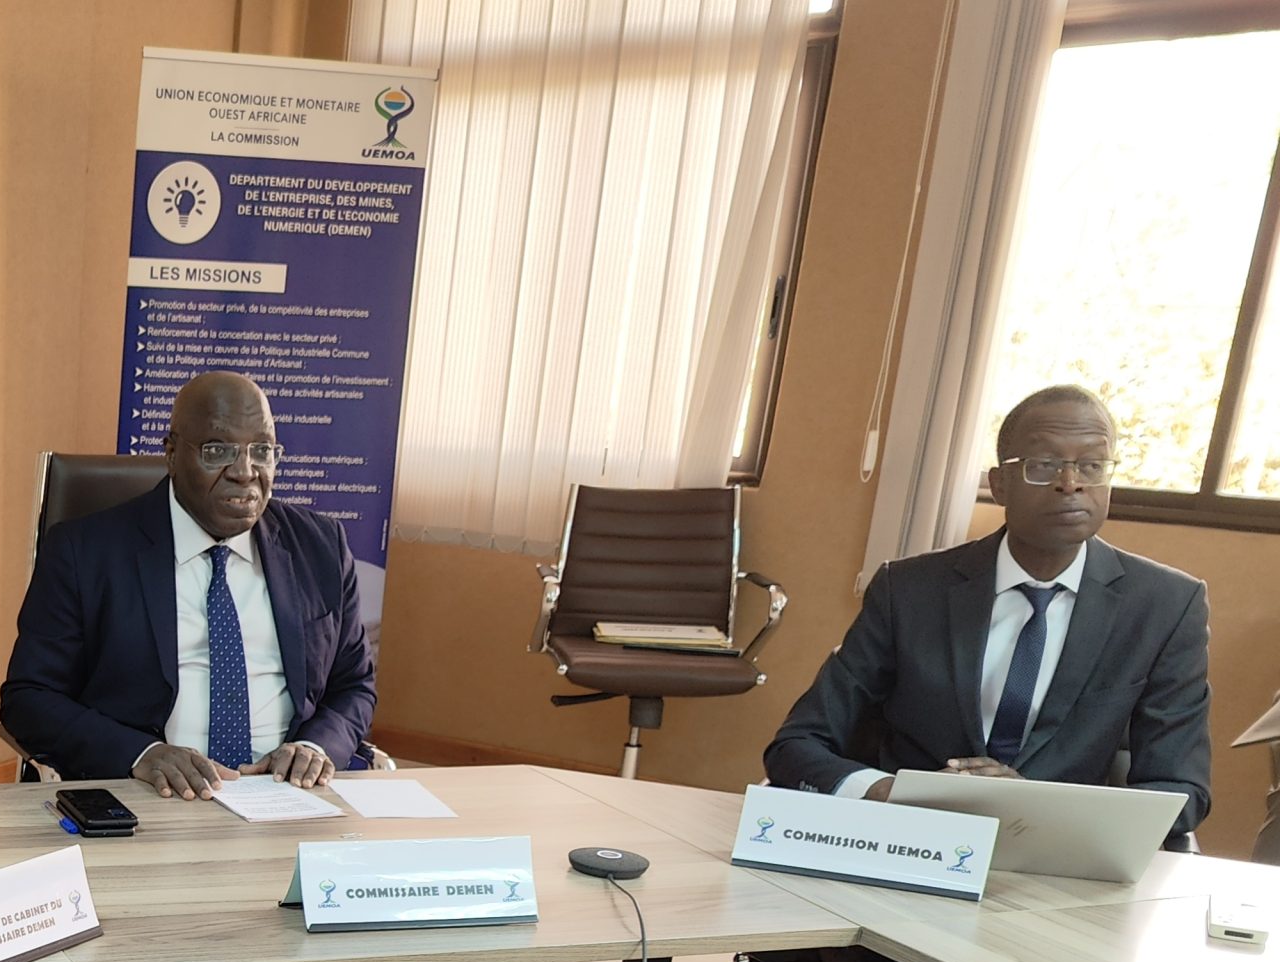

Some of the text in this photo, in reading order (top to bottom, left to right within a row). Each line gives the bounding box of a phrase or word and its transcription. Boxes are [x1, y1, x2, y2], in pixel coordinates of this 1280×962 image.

[155, 88, 361, 113] UNION ECONOMIQUE ET MONETAIRE
[209, 108, 307, 125] OUEST AFRICAINE
[210, 131, 300, 147] LA COMMISSION
[361, 148, 416, 161] UEMOA
[229, 174, 413, 195] DEPARTEMENT DU DEVELOPPEMENT
[245, 190, 395, 210] DE L'ENTREPRISE, DES MINES,
[237, 205, 400, 224] DE L'ENERGIE ET DE L'ECONOMIE
[264, 220, 372, 238] NUMERIQUE (DEMEN)
[149, 266, 262, 285] LES MISSIONS
[147, 312, 155, 322] et
[156, 313, 166, 322] de
[148, 299, 186, 309] Promotion
[187, 301, 196, 310] du
[198, 303, 225, 312] secteur
[249, 304, 259, 313] de
[260, 304, 267, 313] la
[314, 307, 328, 317] des
[329, 308, 369, 319] entreprises
[147, 327, 198, 338] Renforcement
[199, 329, 209, 338] de
[209, 329, 217, 338] la
[218, 330, 263, 341] concertation
[264, 332, 282, 342] avec
[283, 332, 290, 342] le
[291, 333, 319, 343] secteur
[146, 341, 164, 352] Suivi
[166, 342, 176, 352] de
[177, 343, 184, 352] la
[185, 343, 201, 353] mise
[203, 344, 213, 353] en
[240, 345, 250, 355] de
[251, 346, 258, 355] la
[260, 346, 290, 357] Politique
[291, 347, 331, 358] Industrielle
[331, 348, 369, 359] Commune
[146, 355, 154, 364] et
[155, 355, 165, 364] de
[166, 355, 174, 365] la
[175, 354, 205, 366] Politique
[144, 368, 189, 379] Amélioration
[267, 373, 275, 382] et
[276, 373, 283, 383] la
[284, 374, 320, 385] promotion
[321, 375, 331, 384] de
[143, 396, 175, 405] et indust
[278, 387, 293, 397] des
[324, 390, 364, 400] artisanales
[141, 409, 171, 419] Définitio
[294, 414, 332, 424] industrielle
[141, 423, 150, 431] et
[157, 423, 164, 431] la
[140, 436, 163, 446] Protec
[321, 454, 364, 466] numériques
[283, 468, 324, 478] numériques
[294, 482, 307, 491] des
[783, 829, 944, 863] COMMISSION UEMOA
[346, 884, 495, 900] COMMISSAIRE DEMEN
[1, 915, 14, 928] DE
[14, 903, 50, 923] CABINET
[50, 898, 63, 911] DU
[26, 917, 56, 934] DEMEN
